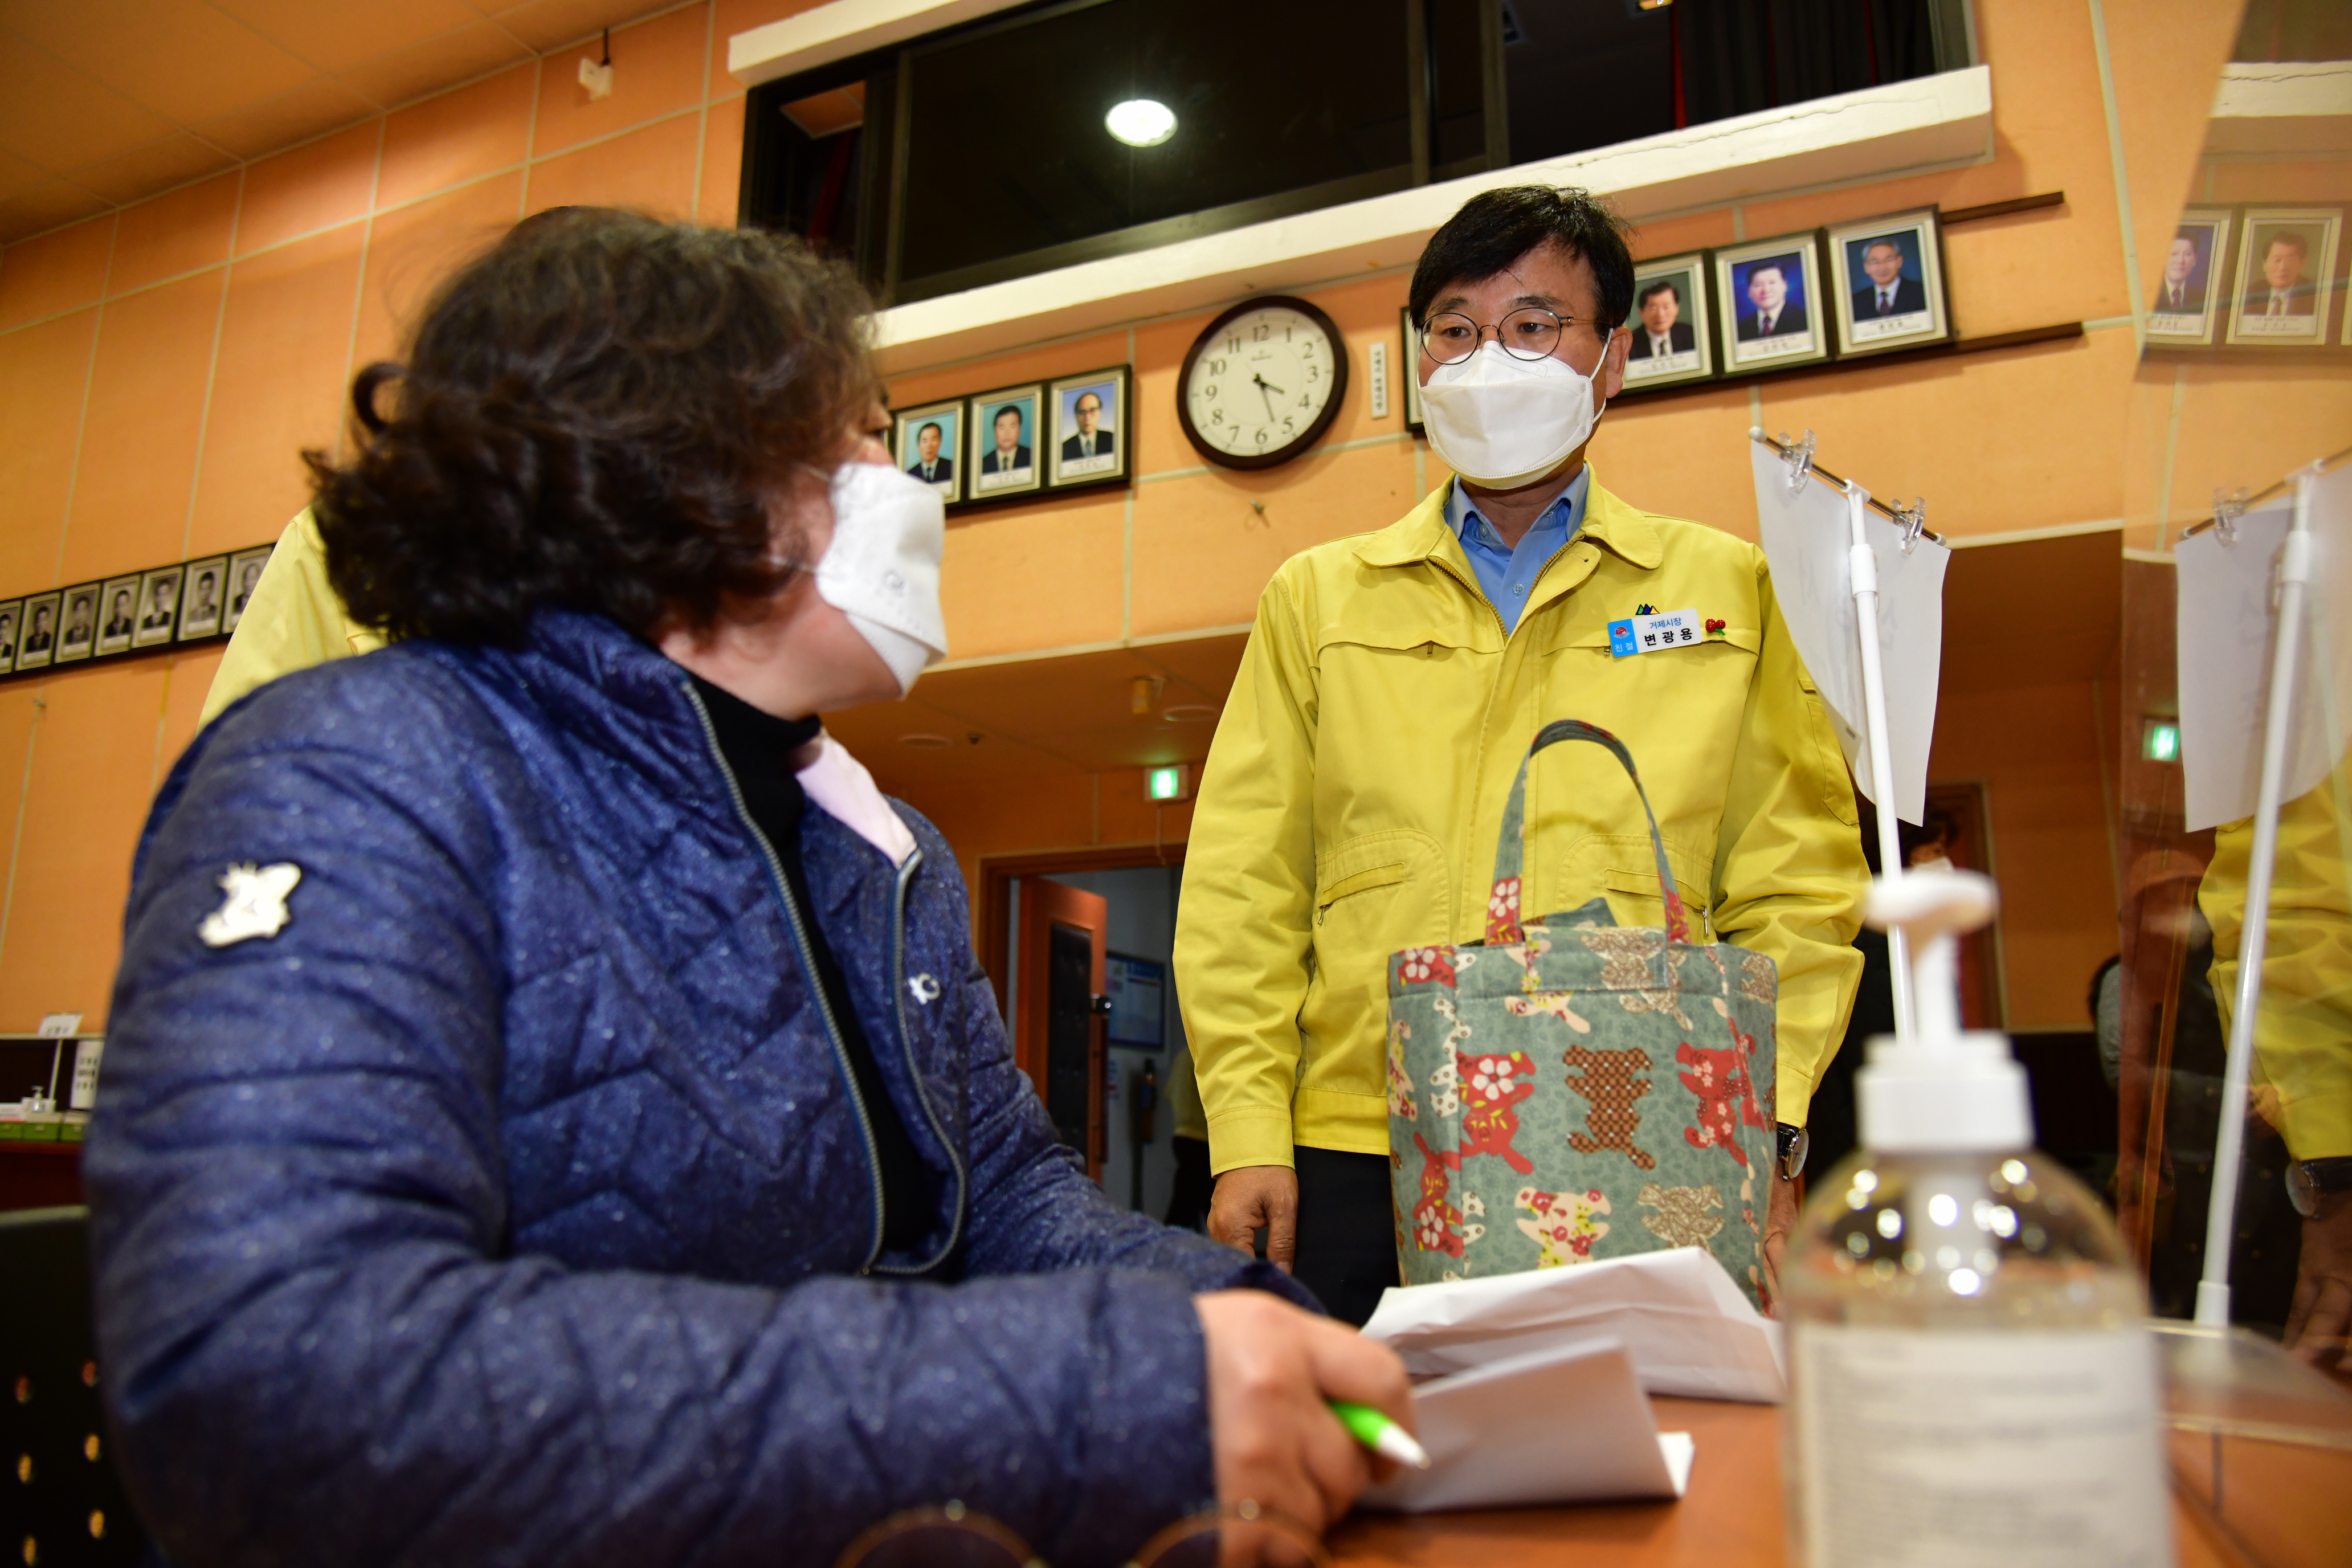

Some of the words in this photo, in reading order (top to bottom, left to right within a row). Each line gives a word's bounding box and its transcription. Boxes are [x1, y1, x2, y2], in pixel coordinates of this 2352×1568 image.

[1253, 324, 1269, 342] 12
[1286, 326, 1292, 342] 1
[1228, 337, 1241, 354] 11
[1302, 342, 1314, 359] 2
[1210, 359, 1227, 377] 10
[1307, 366, 1319, 383] 3
[1205, 385, 1218, 402] 9
[1298, 393, 1310, 410] 4
[1212, 409, 1223, 426] 8
[1281, 416, 1293, 434] 5
[1229, 426, 1240, 443] 7
[1255, 427, 1268, 444] 6
[1649, 617, 1682, 630] 거제시장
